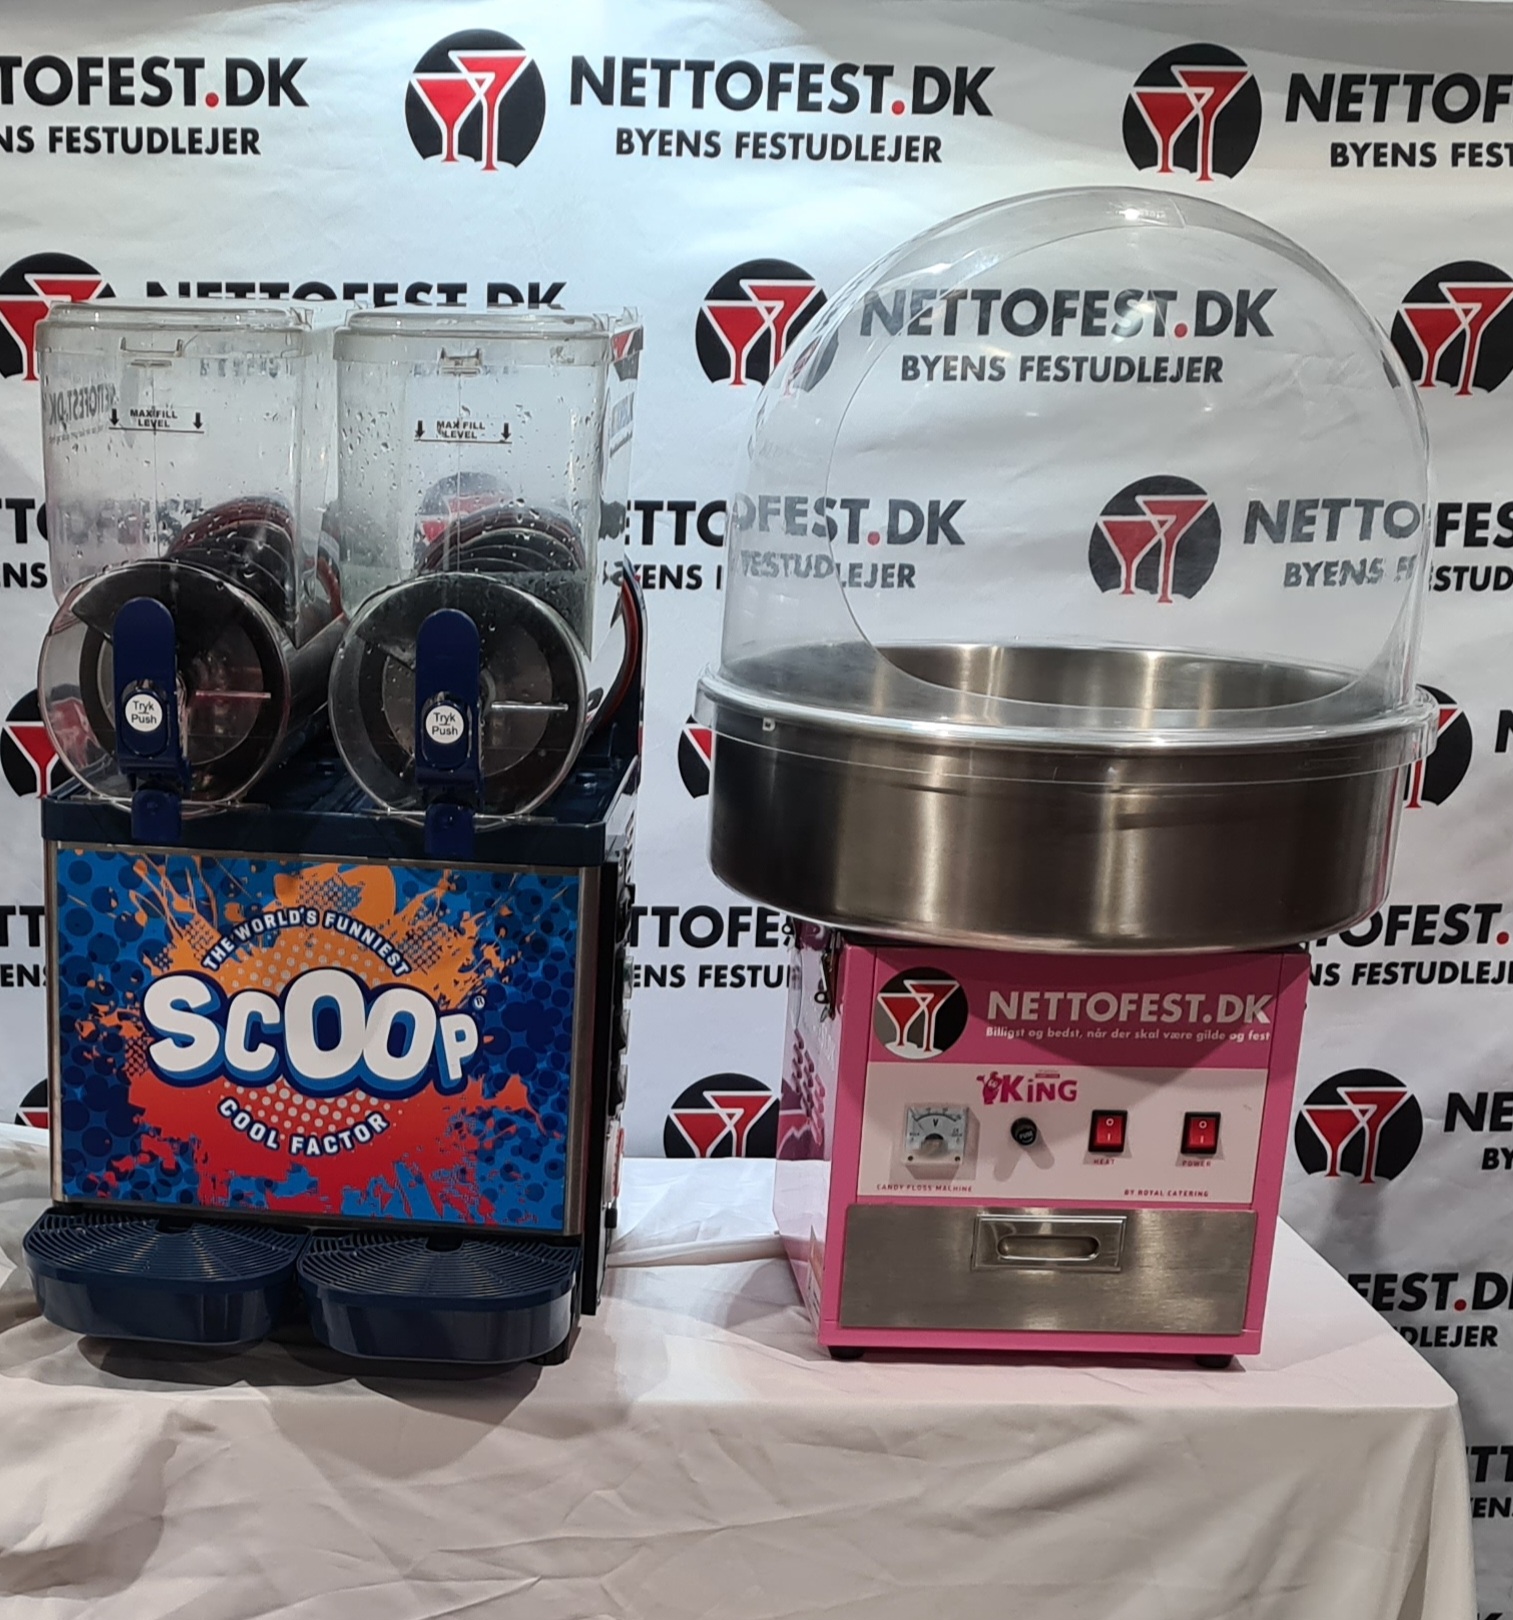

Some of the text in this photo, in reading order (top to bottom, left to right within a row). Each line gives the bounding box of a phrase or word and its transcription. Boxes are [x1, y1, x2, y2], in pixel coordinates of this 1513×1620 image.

[570, 55, 996, 117] NETTOFEST.DK
[1285, 72, 1513, 125] NETTOF
[48, 126, 261, 156] FESTUDLEJER
[616, 128, 943, 163] BYENS FESTUDLEJER
[1330, 142, 1437, 168] BYENS
[860, 287, 1278, 338] NETTOFEST.DK
[901, 354, 1224, 384] BYENS FESTUDLEJER
[138, 418, 170, 428] LEVEL
[156, 410, 178, 419] FILL
[463, 421, 485, 430] FILL
[444, 430, 477, 439] LEVEL
[1283, 557, 1384, 588] BYENS
[131, 713, 157, 724] Push
[132, 700, 155, 714] Tryk
[433, 711, 456, 725] Tryk
[431, 725, 458, 736] Push
[203, 906, 410, 975] THE WORLD'S FUNNIEST
[987, 991, 1273, 1024] NETTOFEST.DK
[985, 1026, 1025, 1040] Billigst
[1028, 1029, 1043, 1040] og
[1087, 1028, 1108, 1039] når
[1111, 1028, 1131, 1039] der
[1134, 1029, 1160, 1040] skal
[1196, 1030, 1226, 1043] gilde
[1229, 1032, 1245, 1043] og
[1248, 1031, 1271, 1041] fest
[219, 1098, 389, 1155] COOL FACTOR
[876, 1183, 903, 1191] CANDY
[935, 1185, 972, 1193] MACHINE
[1138, 1189, 1164, 1197] ROYAL
[1348, 1272, 1513, 1312] FEST.D
[1394, 1325, 1498, 1348] DLEJER
